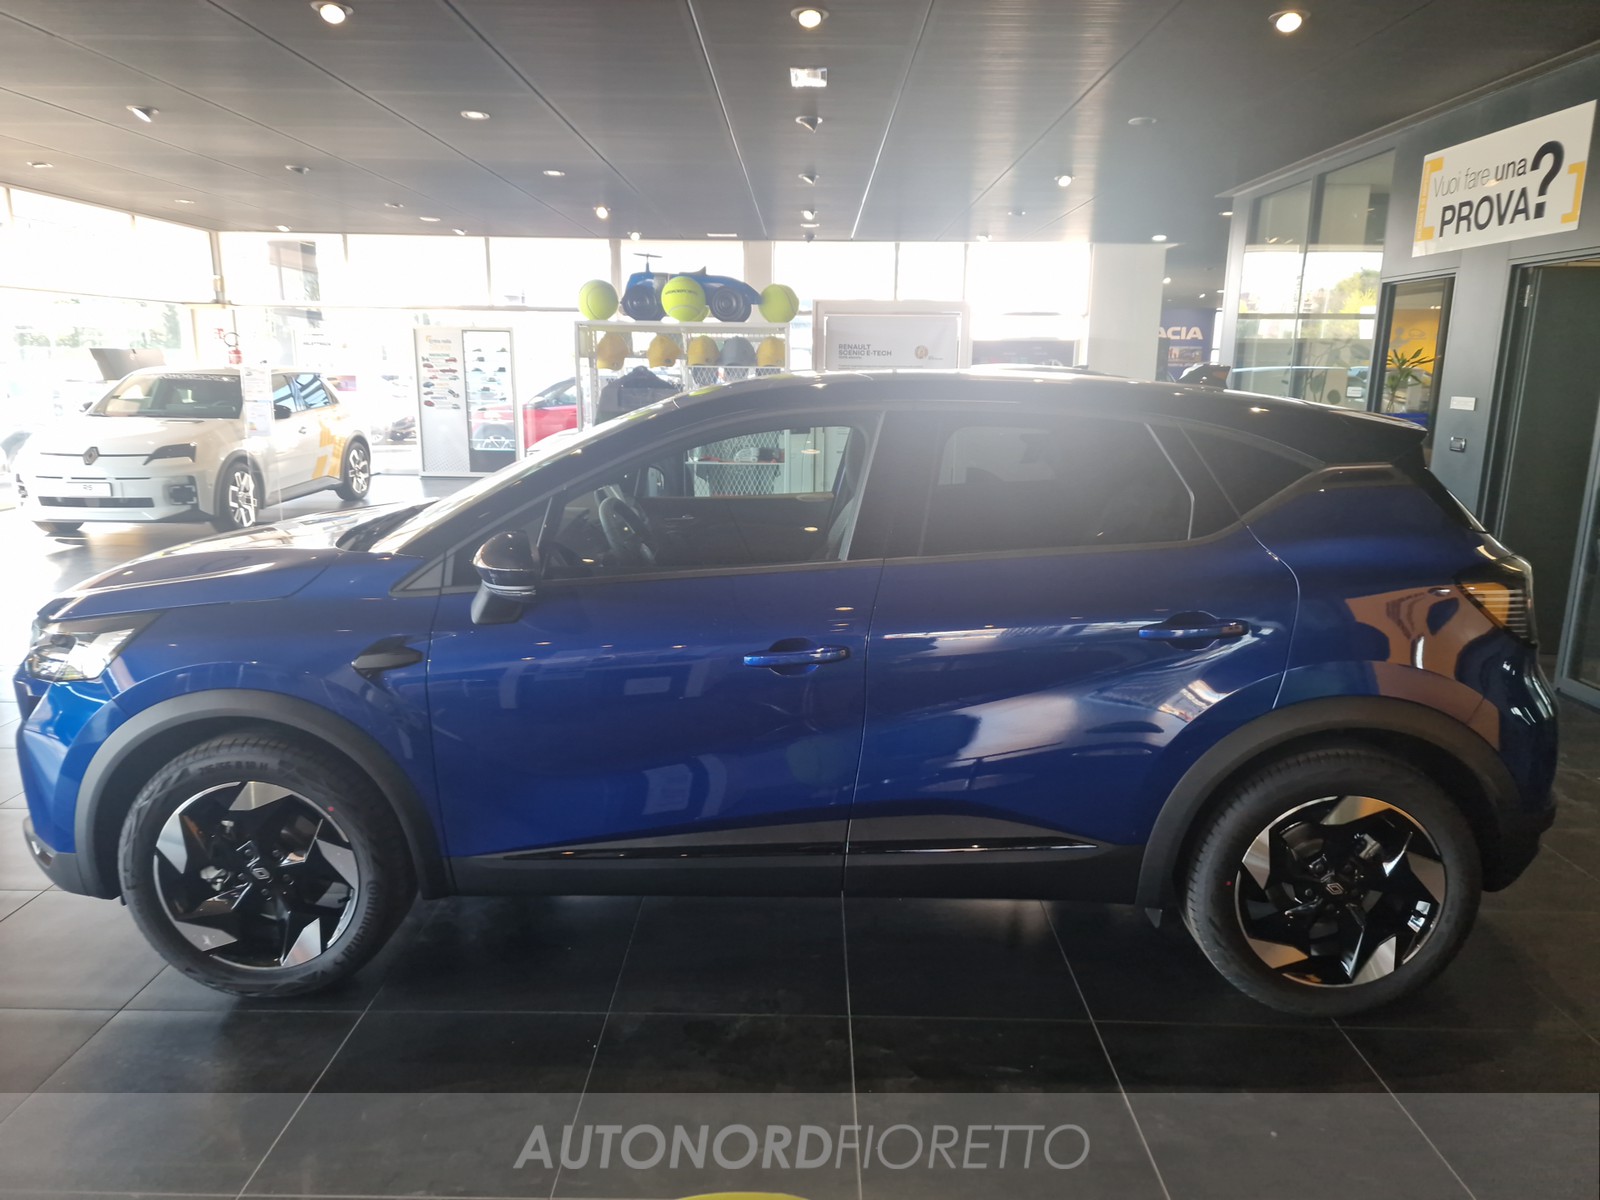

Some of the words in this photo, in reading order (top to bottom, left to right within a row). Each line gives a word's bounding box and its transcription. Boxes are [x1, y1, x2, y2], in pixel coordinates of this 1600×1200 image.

[1433, 170, 1461, 198] Vuoi
[1464, 166, 1491, 191] fare
[1494, 158, 1527, 182] una
[1439, 187, 1531, 238] PROVA
[838, 343, 871, 351] RENAULT
[1156, 326, 1204, 340] ACIA
[342, 881, 379, 958] Continental
